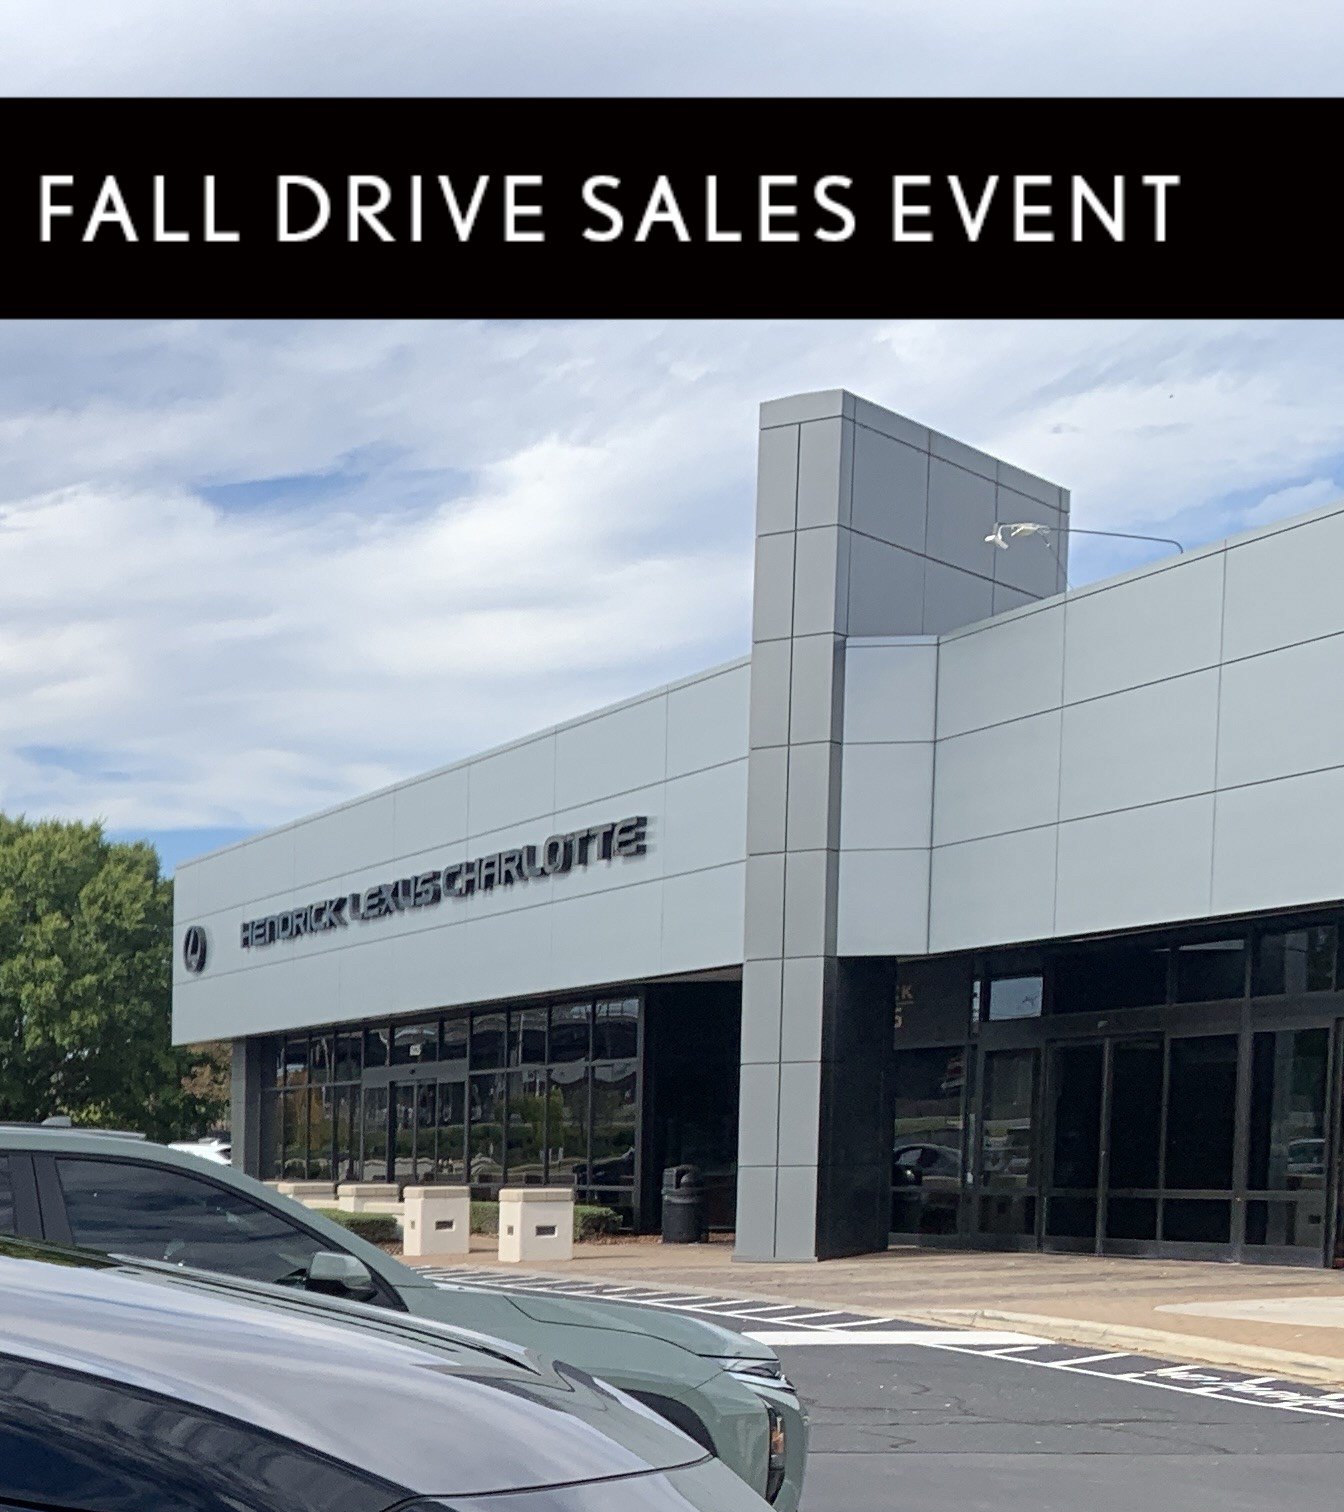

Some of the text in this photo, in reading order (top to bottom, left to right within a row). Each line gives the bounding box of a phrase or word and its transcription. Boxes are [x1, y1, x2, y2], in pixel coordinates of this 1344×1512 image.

[240, 815, 648, 948] HENDRICK LEXUS CHARLOTTE
